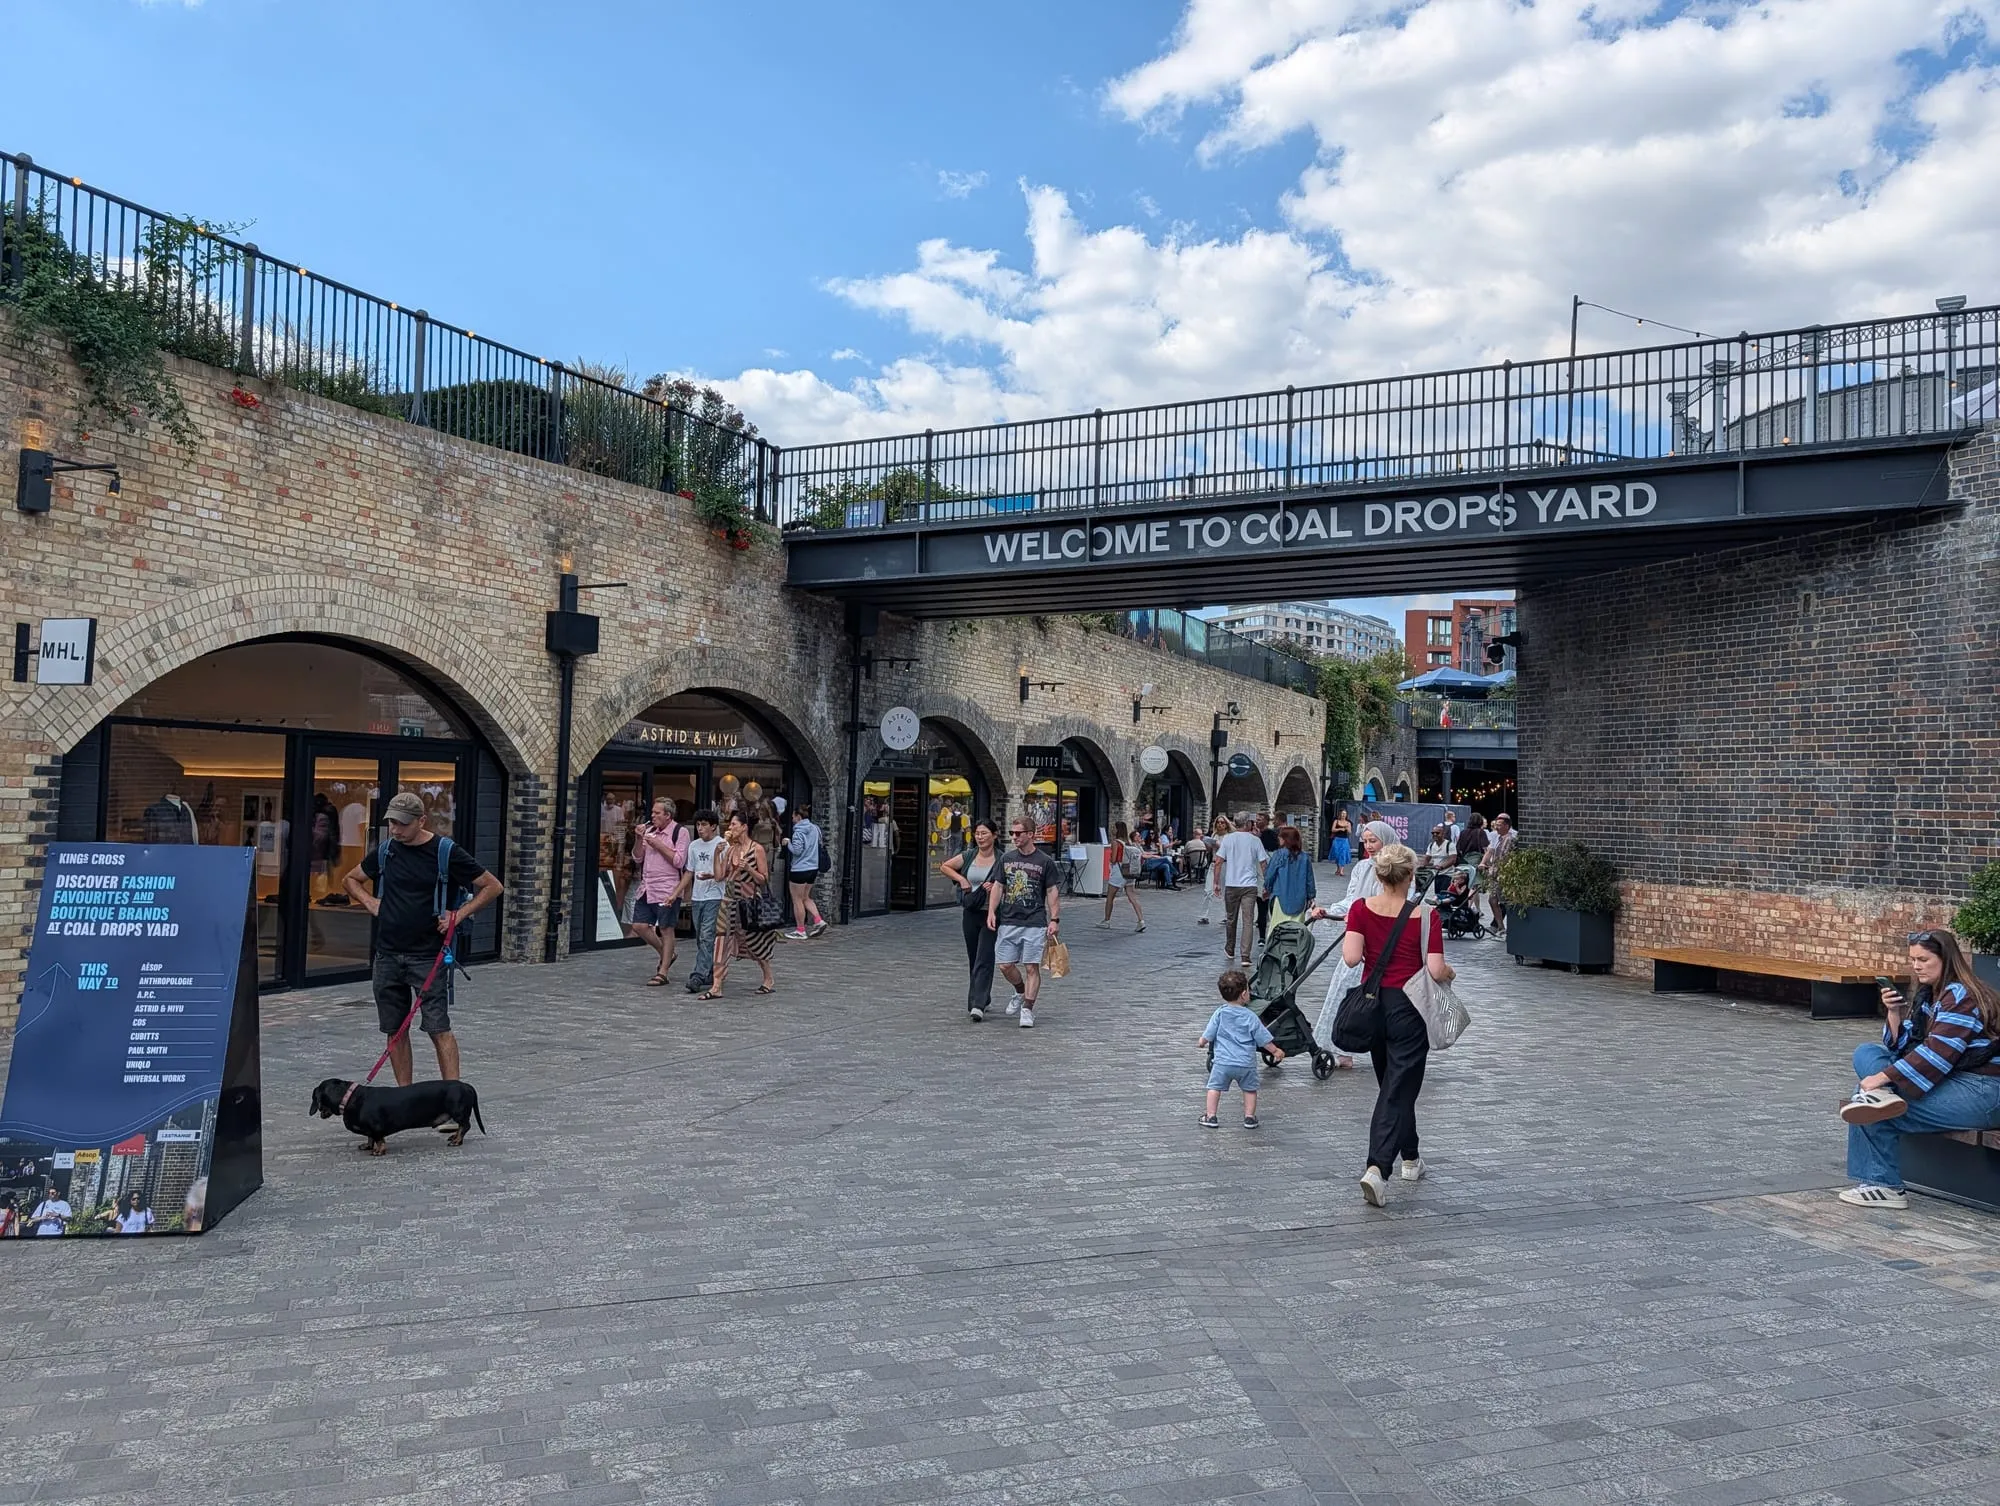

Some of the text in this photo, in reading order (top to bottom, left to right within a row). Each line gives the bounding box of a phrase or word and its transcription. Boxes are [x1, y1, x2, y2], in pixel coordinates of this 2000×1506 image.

[983, 481, 1658, 563] WELCOME TO COAL DROPS YARD
[41, 641, 84, 661] MHL.
[887, 713, 912, 725] ASTRID
[640, 727, 738, 747] ASTRID & MIYU
[1025, 756, 1059, 768] CUBITTS
[1380, 815, 1409, 828] INGS
[91, 853, 125, 866] CROSS
[56, 874, 176, 890] DISCOVER FASHION
[53, 890, 155, 905] FAVOURITES AND
[50, 906, 170, 923] BOUTIQUE BRANDS
[46, 922, 179, 937] AT COAL DROPS YARD
[80, 963, 109, 976] THIS
[77, 977, 119, 990] WAY TO
[139, 977, 194, 985] ANTHROPOLOGIE
[136, 991, 157, 999] A.P.C.
[134, 1005, 184, 1013] ASTRID & MIYU
[132, 1019, 147, 1027] COS
[130, 1032, 160, 1041] CUBITTS
[128, 1047, 168, 1055] PAUL SMITH
[125, 1061, 151, 1070] UNIQLO
[123, 1075, 186, 1083] UNIVERSAL WORKS
